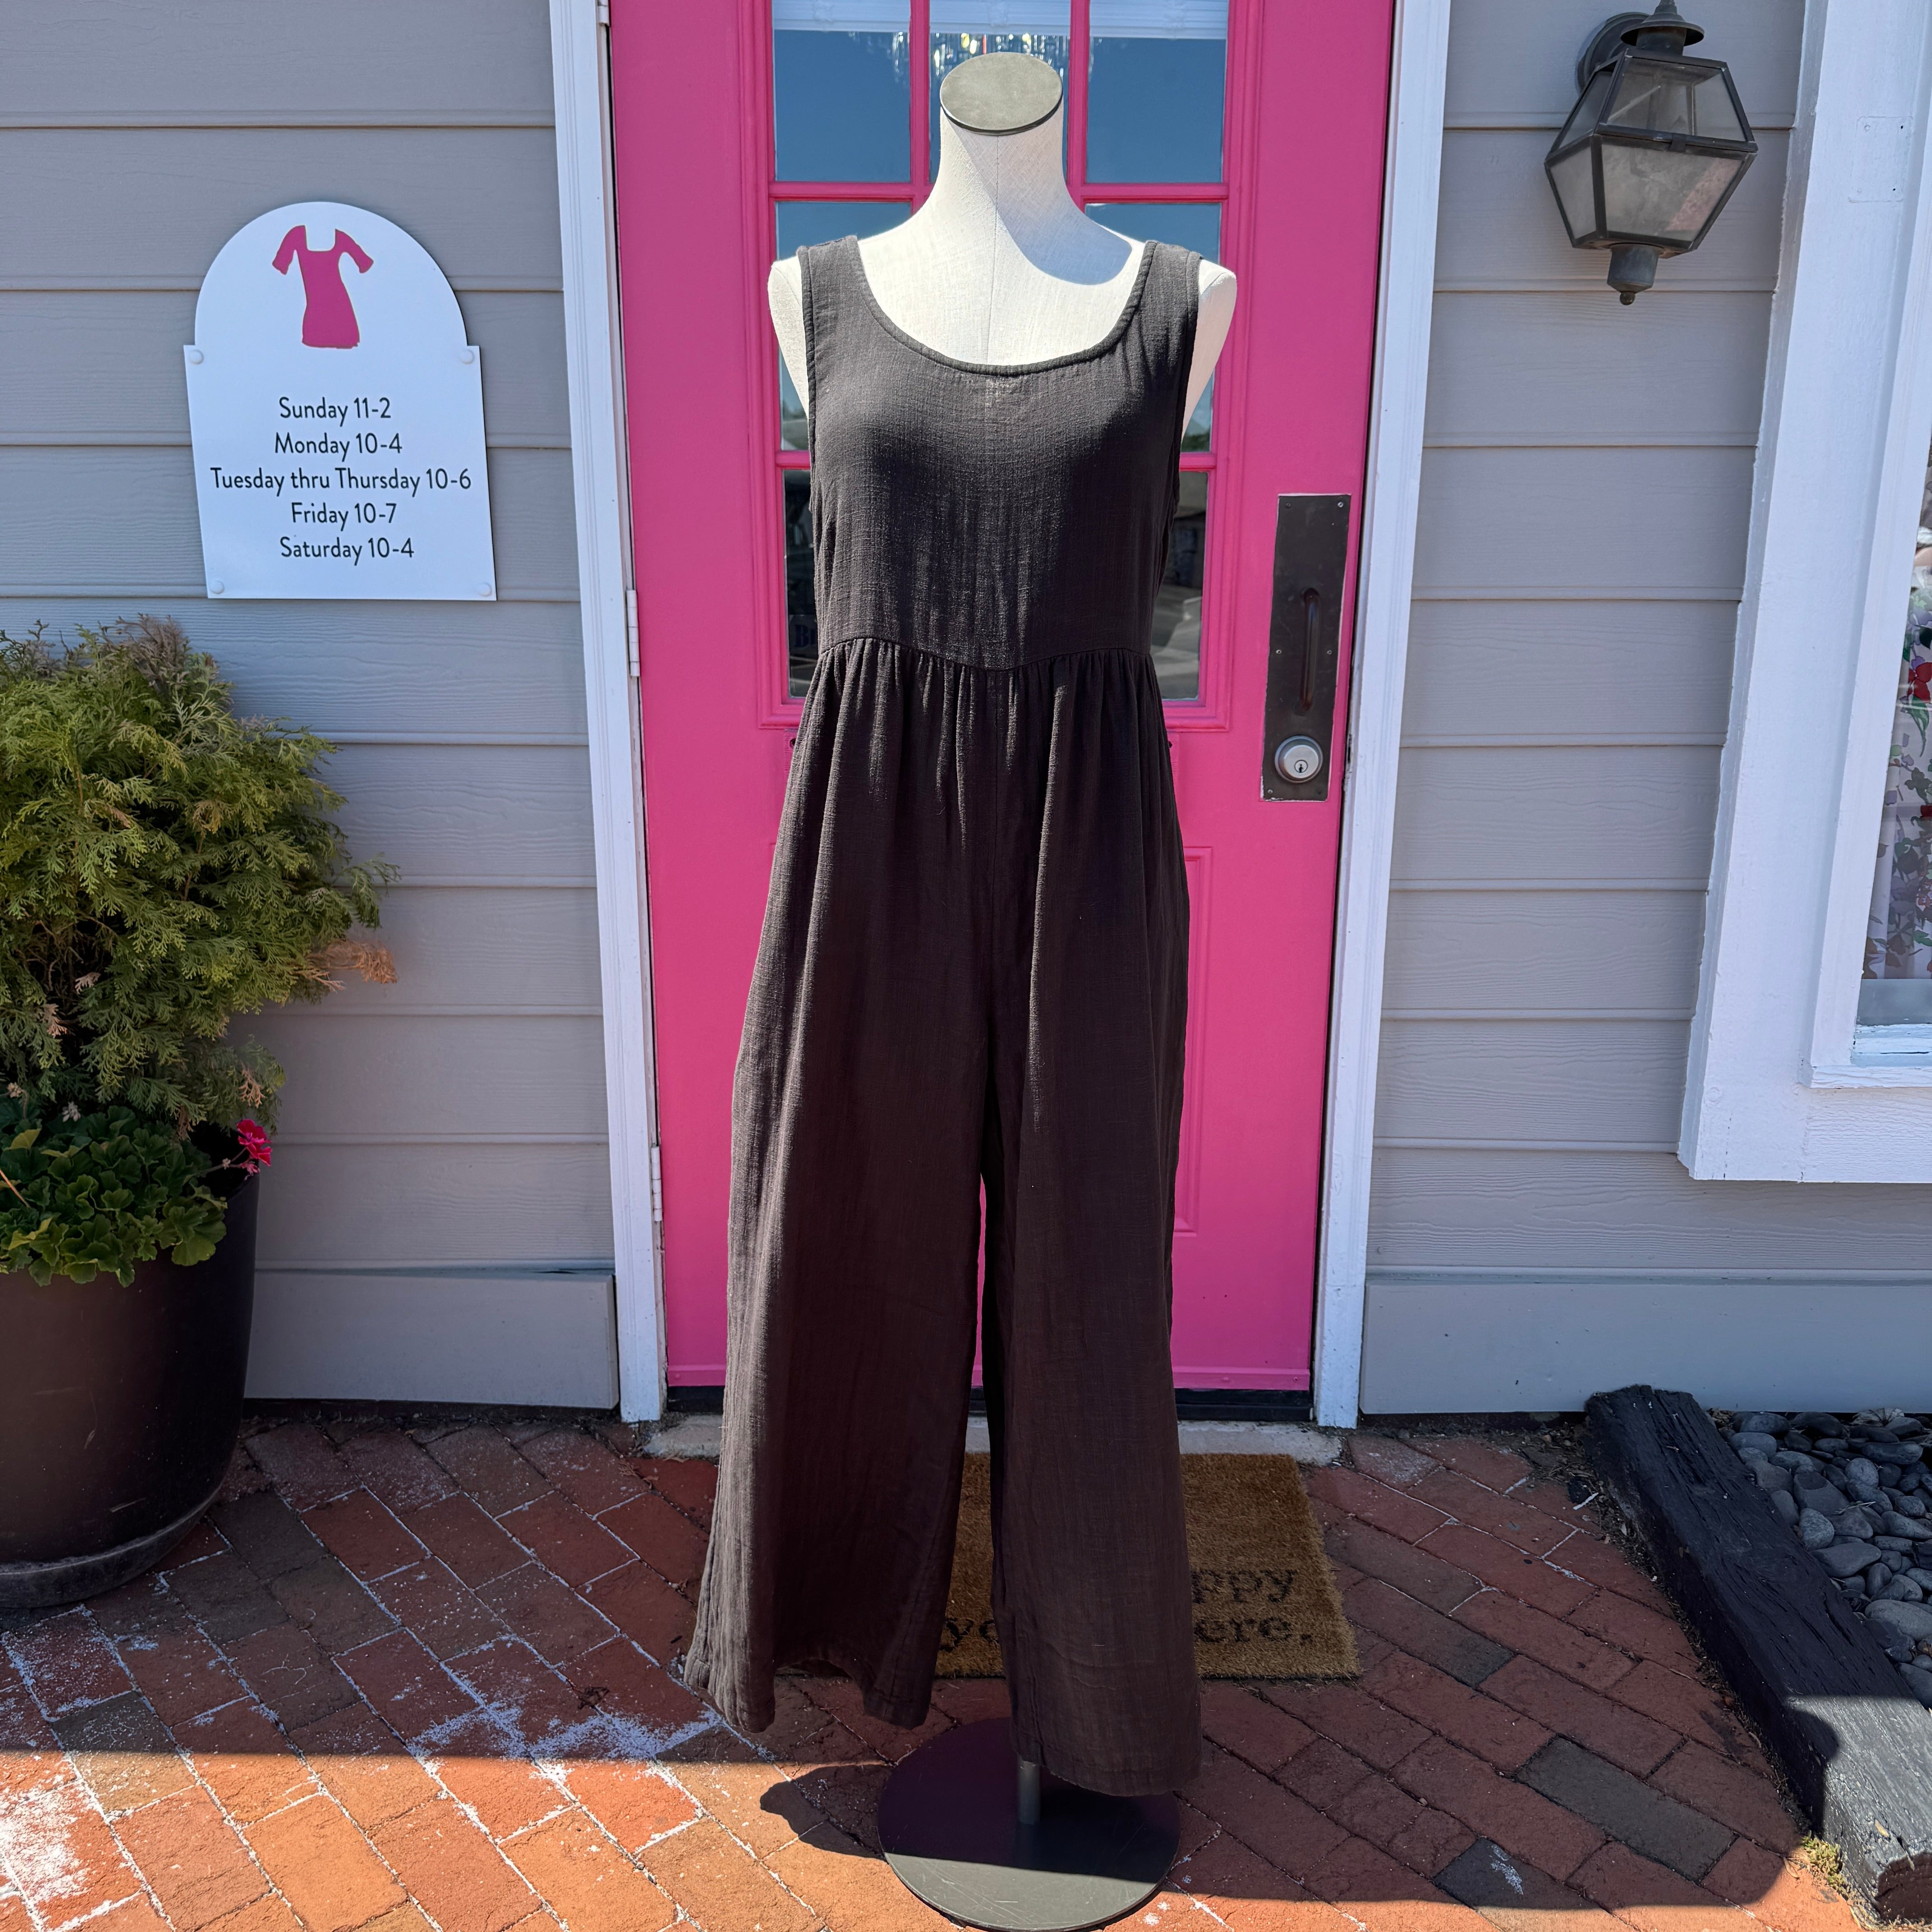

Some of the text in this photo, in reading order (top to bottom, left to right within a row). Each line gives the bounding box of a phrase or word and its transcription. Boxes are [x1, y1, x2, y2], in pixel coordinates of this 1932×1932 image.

[279, 396, 391, 427] Sunday 11-2
[274, 432, 403, 462] Monday 10-4
[210, 467, 472, 498] Tuesday thru Thursday 10-6
[291, 502, 397, 532] Friday 10-7
[280, 536, 415, 566] Saturday 10-4
[1191, 1569, 1296, 1604] ppy
[1193, 1617, 1312, 1644] ere.
